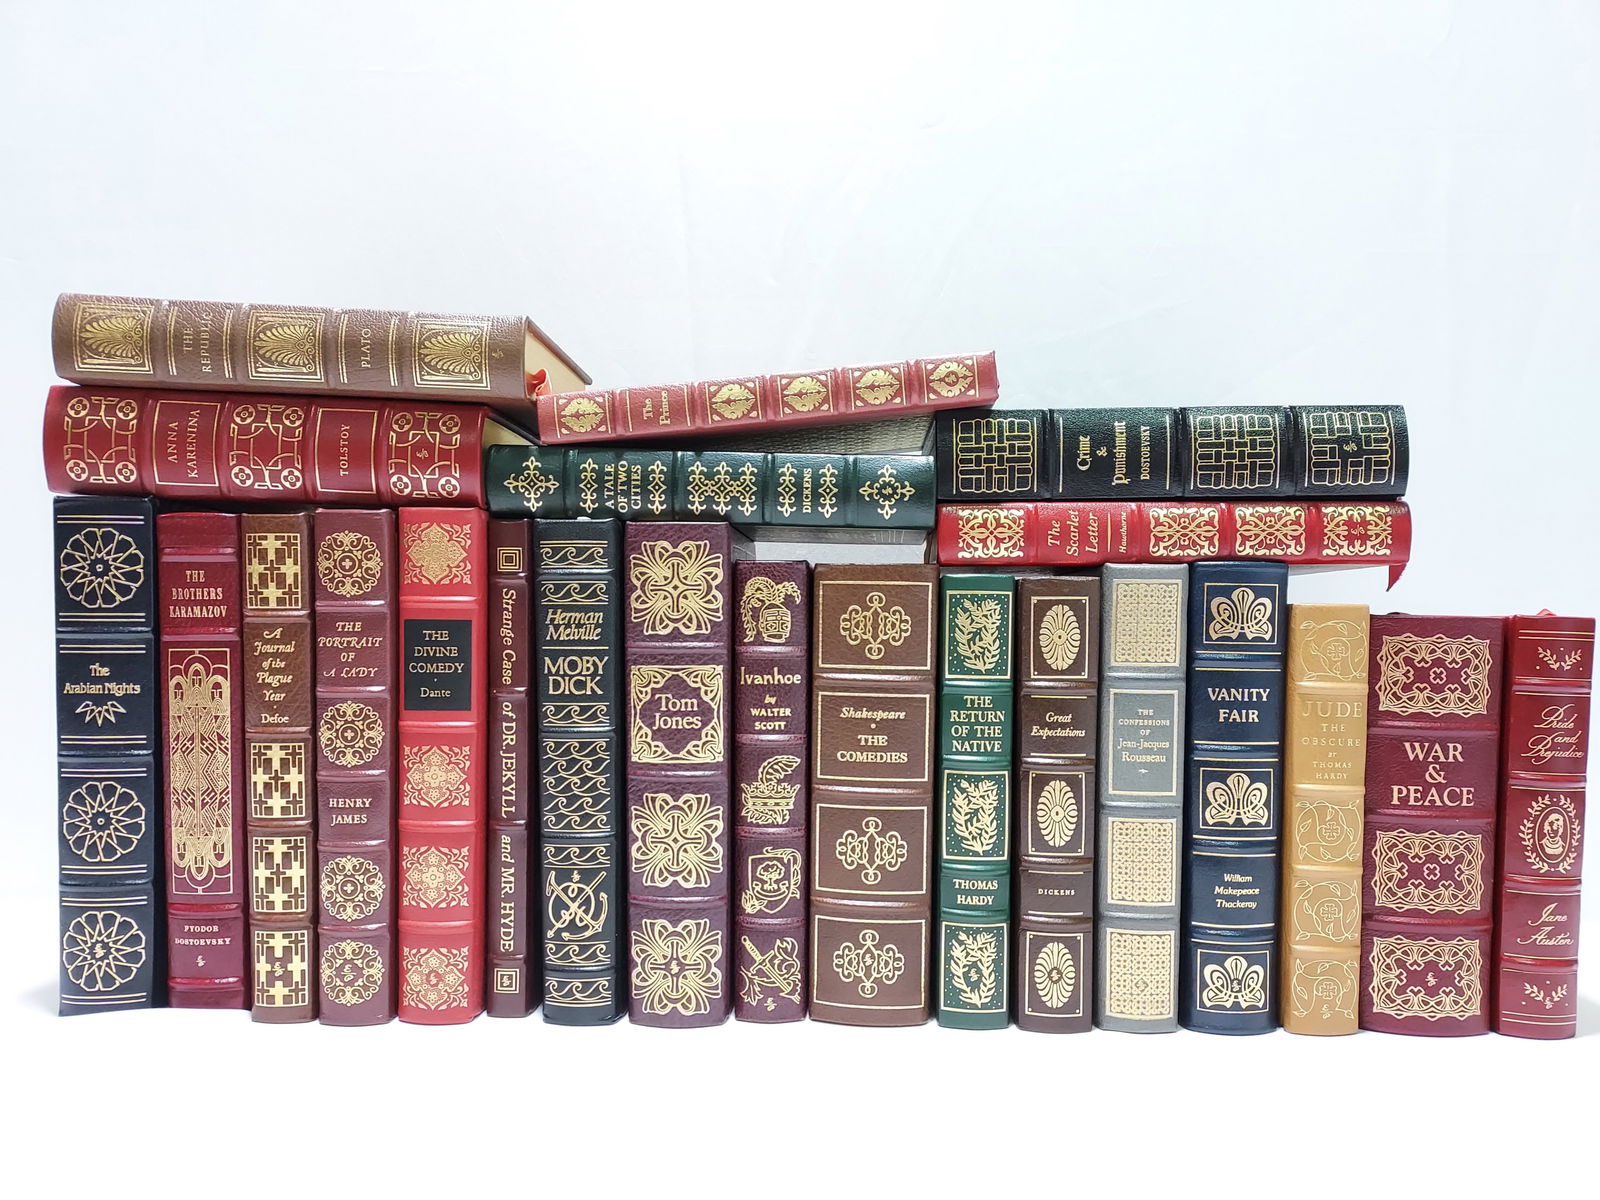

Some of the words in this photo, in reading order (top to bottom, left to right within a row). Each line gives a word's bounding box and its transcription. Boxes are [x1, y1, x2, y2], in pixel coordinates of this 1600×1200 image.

[184, 327, 193, 353] THE
[361, 327, 371, 368] PLATO
[642, 398, 653, 419] The
[659, 390, 670, 424] Prince
[167, 421, 179, 463] ANNA
[186, 408, 199, 479] KARENINA
[339, 424, 350, 476] TOLSTOY
[1076, 436, 1092, 471] Crime
[1097, 447, 1107, 456] &
[1112, 421, 1130, 486] Punishment
[1140, 425, 1150, 480] DOSTOEVSKY
[604, 464, 614, 497] TALE
[618, 461, 628, 493] TWO
[631, 465, 642, 509] CITIES
[803, 469, 812, 514] DICKENS
[605, 498, 614, 508] A
[618, 495, 628, 512] OF
[1048, 520, 1061, 547] The
[1065, 510, 1079, 556] Scarlet
[1084, 512, 1098, 554] Letter
[1118, 511, 1127, 554] Hawthorne
[186, 570, 205, 583] THE
[172, 588, 222, 600] BROTHERS
[169, 606, 227, 618] KARAMAZOV
[501, 589, 516, 646] Strange
[545, 609, 603, 624] Herman
[264, 628, 282, 639] A
[336, 621, 362, 632] THE
[546, 625, 601, 641] Melville
[318, 637, 382, 647] PORTRAIT
[423, 630, 449, 641] THE
[254, 641, 294, 654] Journal
[414, 647, 458, 656] DIVINE
[262, 659, 271, 669] of
[272, 658, 285, 668] the
[341, 652, 355, 662] OF
[90, 663, 110, 676] The
[323, 668, 335, 677] A
[341, 667, 378, 678] LADY
[409, 663, 464, 673] COMEDY
[502, 651, 516, 685] Case
[544, 656, 608, 675] MOBY
[256, 671, 292, 685] Plague
[740, 668, 801, 685] Ivanhoe
[64, 682, 103, 694] Arabian
[104, 682, 140, 696] Nights
[420, 688, 450, 697] Dante
[548, 676, 603, 695] DICK
[263, 690, 285, 702] Year
[765, 695, 776, 705] by
[964, 696, 992, 707] THE
[1208, 688, 1270, 702] VANITY
[655, 694, 698, 711] Tom
[1302, 701, 1362, 718] JUDE
[502, 702, 515, 720] of
[751, 708, 791, 717] WALTER
[840, 708, 906, 720] Shakespeare
[950, 711, 1005, 722] RETURN
[1046, 712, 1072, 723] Great
[1219, 709, 1259, 722] FAIR
[1534, 704, 1575, 729] Pride
[261, 714, 289, 724] Defoe
[653, 713, 701, 730] Jones
[755, 722, 786, 730] SCOTT
[1119, 718, 1170, 726] CONFESSIONS
[951, 726, 968, 737] OF
[974, 726, 1002, 737] THE
[1031, 726, 1086, 739] Expectations
[1321, 723, 1346, 732] THE
[501, 722, 515, 752] DR.
[858, 735, 887, 746] THE
[1302, 738, 1360, 746] OBSCURE
[1554, 731, 1582, 743] and
[952, 741, 1001, 752] NATIVE
[1117, 739, 1169, 751] Jean-Jacques
[1521, 733, 1584, 764] Prejudice
[837, 751, 908, 763] COMEDIES
[1122, 752, 1166, 762] Rousseau
[1403, 743, 1464, 762] WAR
[1315, 772, 1347, 780] HARDY
[1425, 764, 1447, 783] &
[500, 754, 516, 818] JEKYLL
[1391, 785, 1474, 806] PEACE
[329, 798, 371, 808] HENRY
[332, 814, 367, 826] JAMES
[501, 835, 514, 862] and
[501, 867, 514, 899] MR.
[953, 880, 998, 890] THOMAS
[1224, 874, 1252, 882] William
[957, 895, 994, 906] HARDY
[1528, 903, 1567, 926] Jane
[501, 902, 514, 952] HYDE
[1517, 926, 1573, 945] Austen
